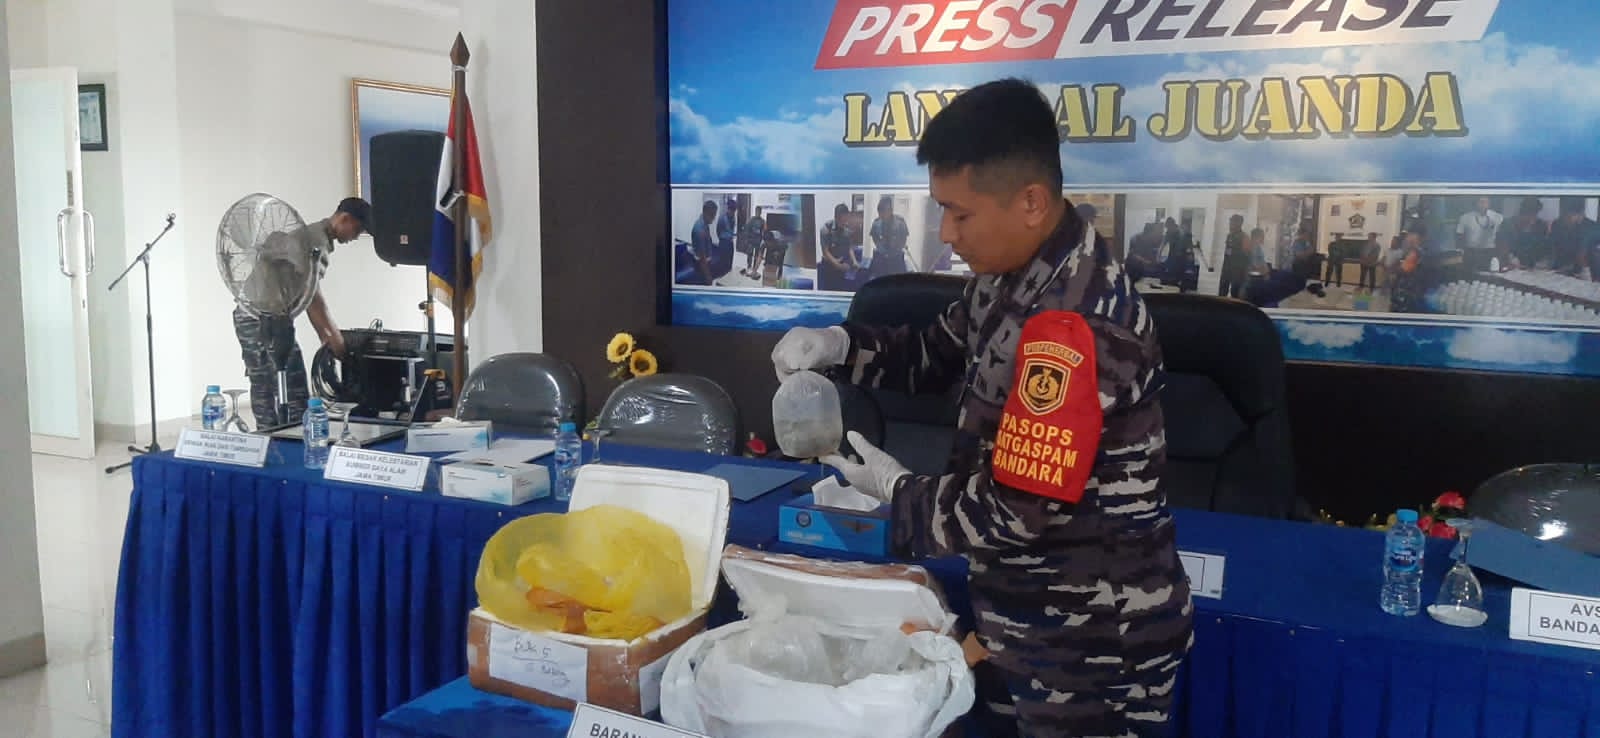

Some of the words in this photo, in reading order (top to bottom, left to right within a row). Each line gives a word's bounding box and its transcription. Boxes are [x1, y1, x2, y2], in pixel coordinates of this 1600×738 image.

[833, 0, 1073, 56] PRESS
[1079, 0, 1455, 44] RELEASE
[843, 83, 1136, 147] LANAL
[1146, 70, 1470, 143] JUANDA
[1002, 412, 1073, 446] PASOPS
[994, 449, 1063, 487] BANDARA
